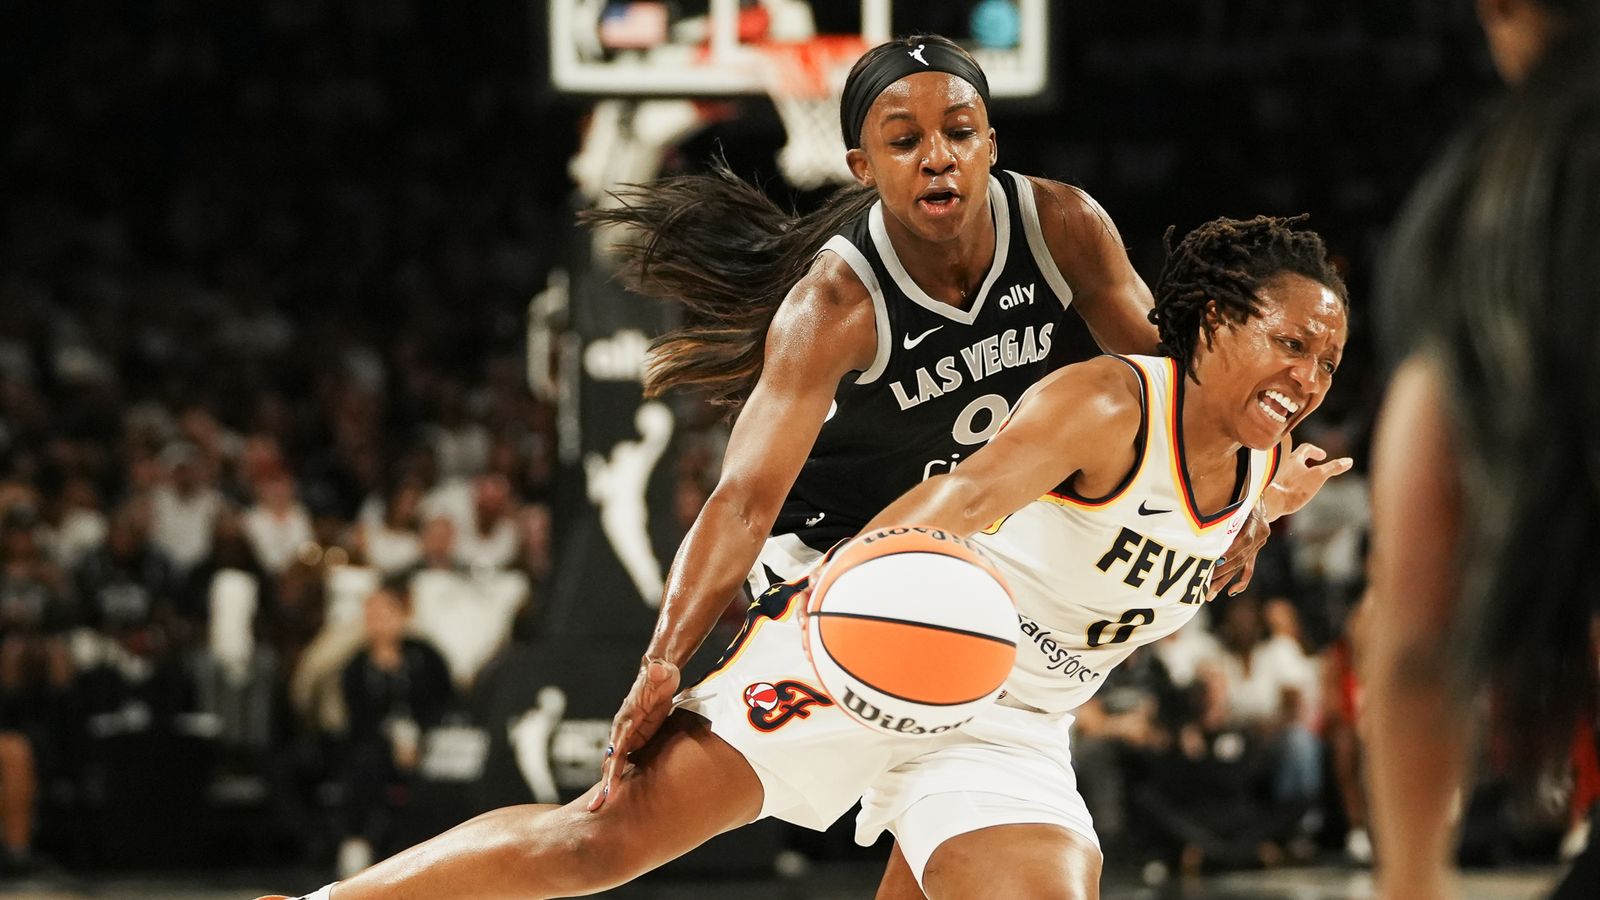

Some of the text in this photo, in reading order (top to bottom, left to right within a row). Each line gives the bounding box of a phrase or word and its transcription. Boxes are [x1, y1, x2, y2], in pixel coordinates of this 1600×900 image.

[1000, 283, 1035, 311] ally
[889, 322, 1054, 411] LAS VEGAS
[952, 393, 1010, 445] 0
[1086, 608, 1155, 648] 0
